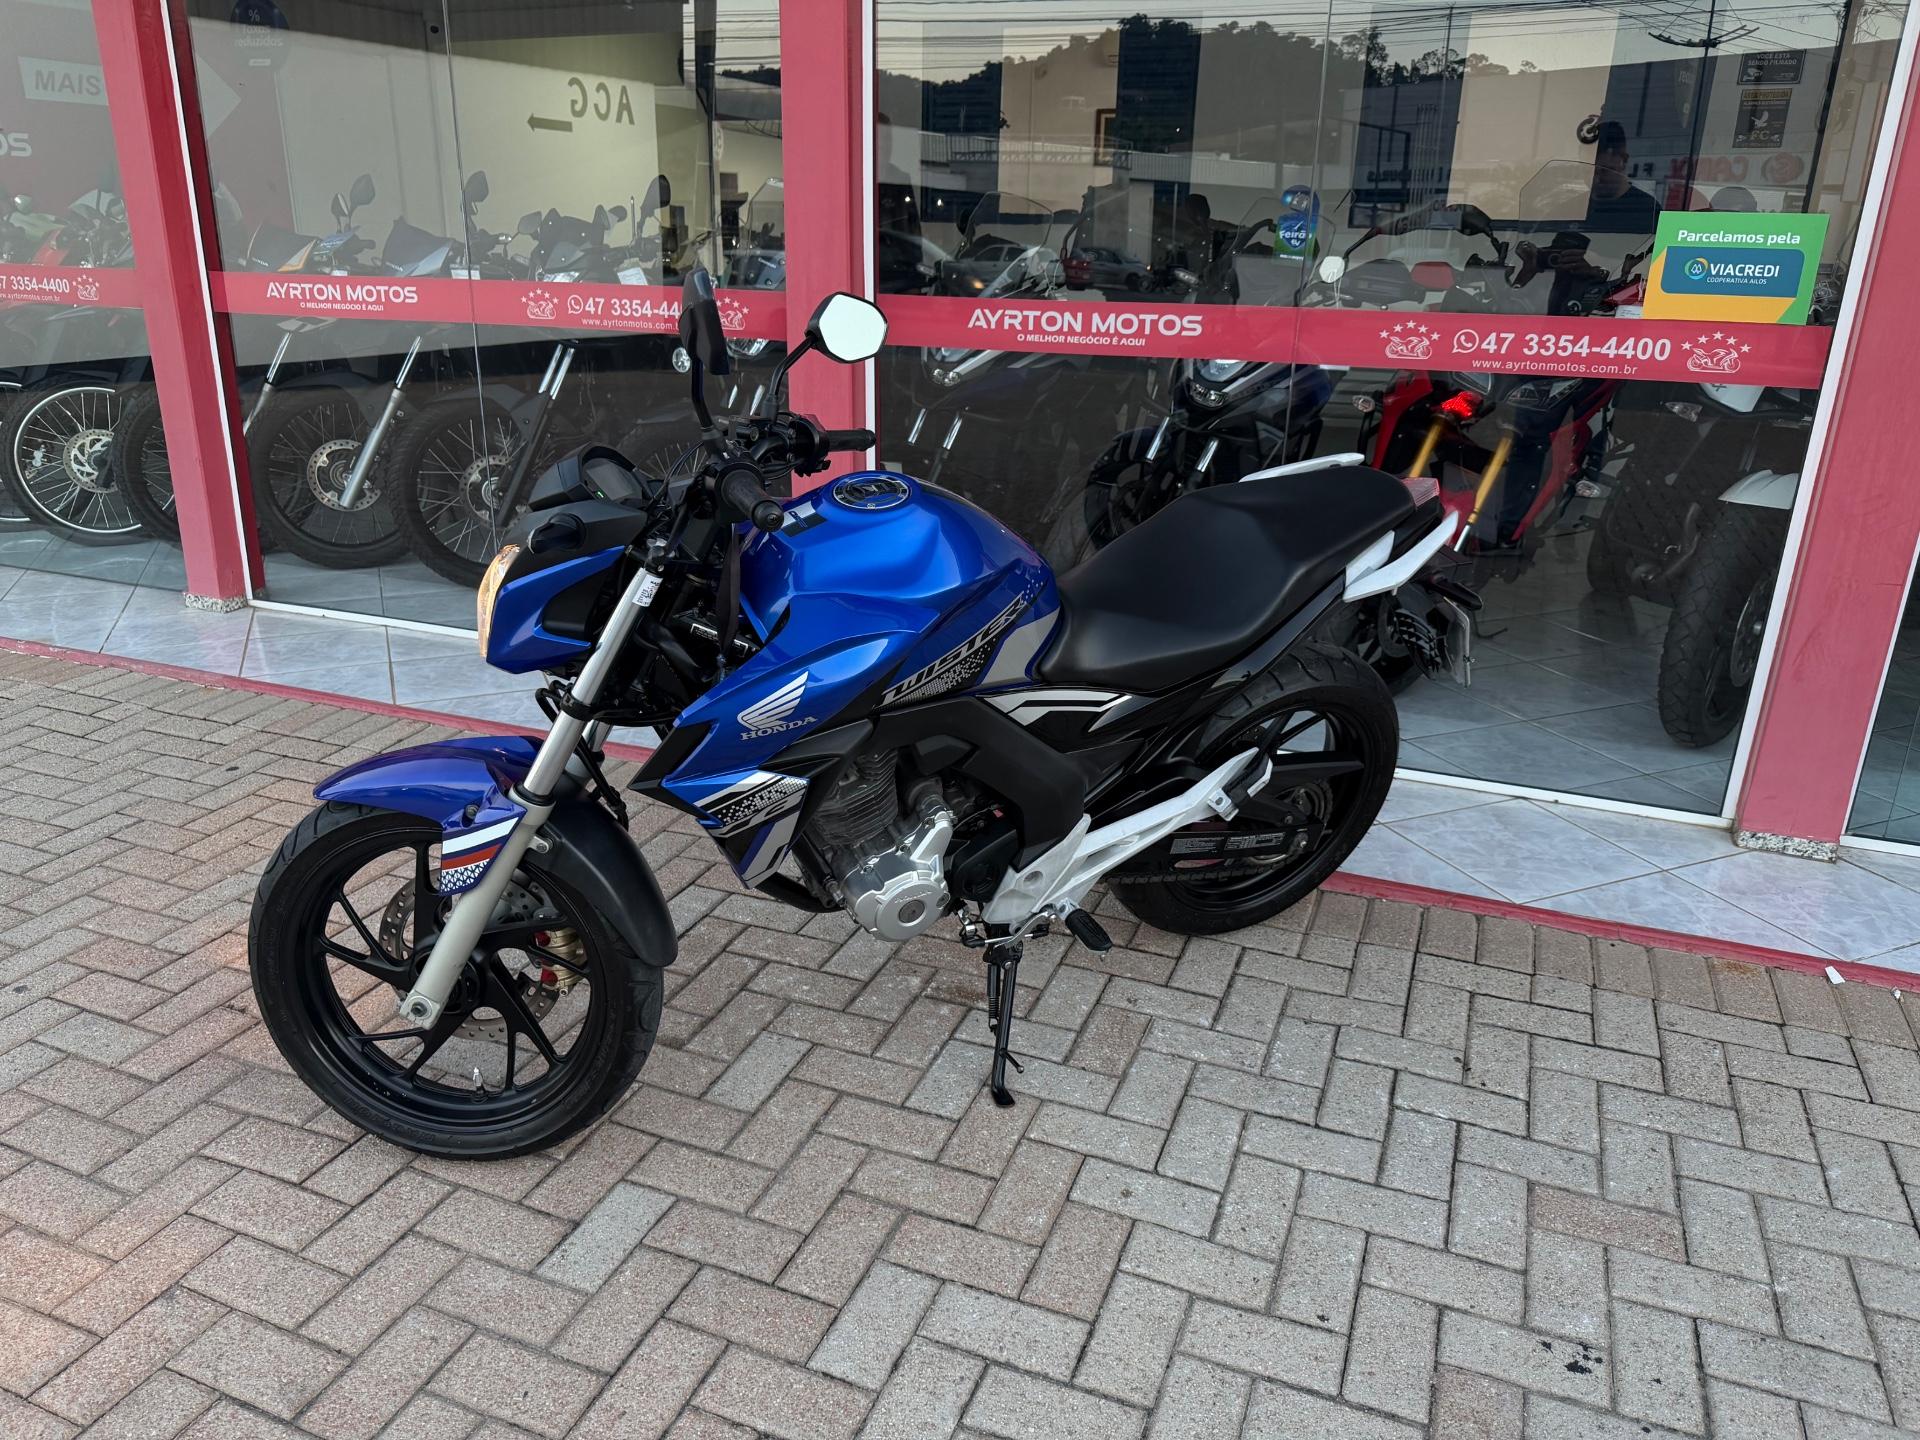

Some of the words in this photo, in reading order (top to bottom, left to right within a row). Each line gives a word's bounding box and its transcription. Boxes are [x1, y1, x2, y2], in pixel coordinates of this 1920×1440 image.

[34, 69, 101, 97] MAIS
[1677, 230, 1764, 244] Parcelamos
[1767, 232, 1801, 247] pela
[1709, 263, 1780, 278] VIACREDI
[10, 275, 70, 293] 3354-4400
[1706, 276, 1748, 284] COOPERATIVA
[266, 282, 341, 301] AYRTON
[346, 284, 418, 304] MOTOS
[306, 302, 332, 310] MELHOR
[333, 302, 361, 311] NEGÓCIO
[367, 304, 384, 312] AQUI
[585, 297, 605, 315] 47
[611, 298, 682, 319] 3354-44
[582, 317, 679, 329] www.ayrtonmotos.com.
[967, 308, 1082, 333] AYRTON
[1091, 312, 1203, 337] MOTOS
[1017, 334, 1025, 342] O
[1026, 334, 1065, 344] MELHOR
[1067, 334, 1110, 345] NEGÓCIO
[1112, 335, 1118, 346] É
[1120, 337, 1146, 347] AQUI
[1481, 331, 1516, 354] 47
[1523, 333, 1672, 361] 3354-4400
[1472, 359, 1638, 375] www.ayrtonmotos.com.br
[740, 716, 818, 741] HONDA
